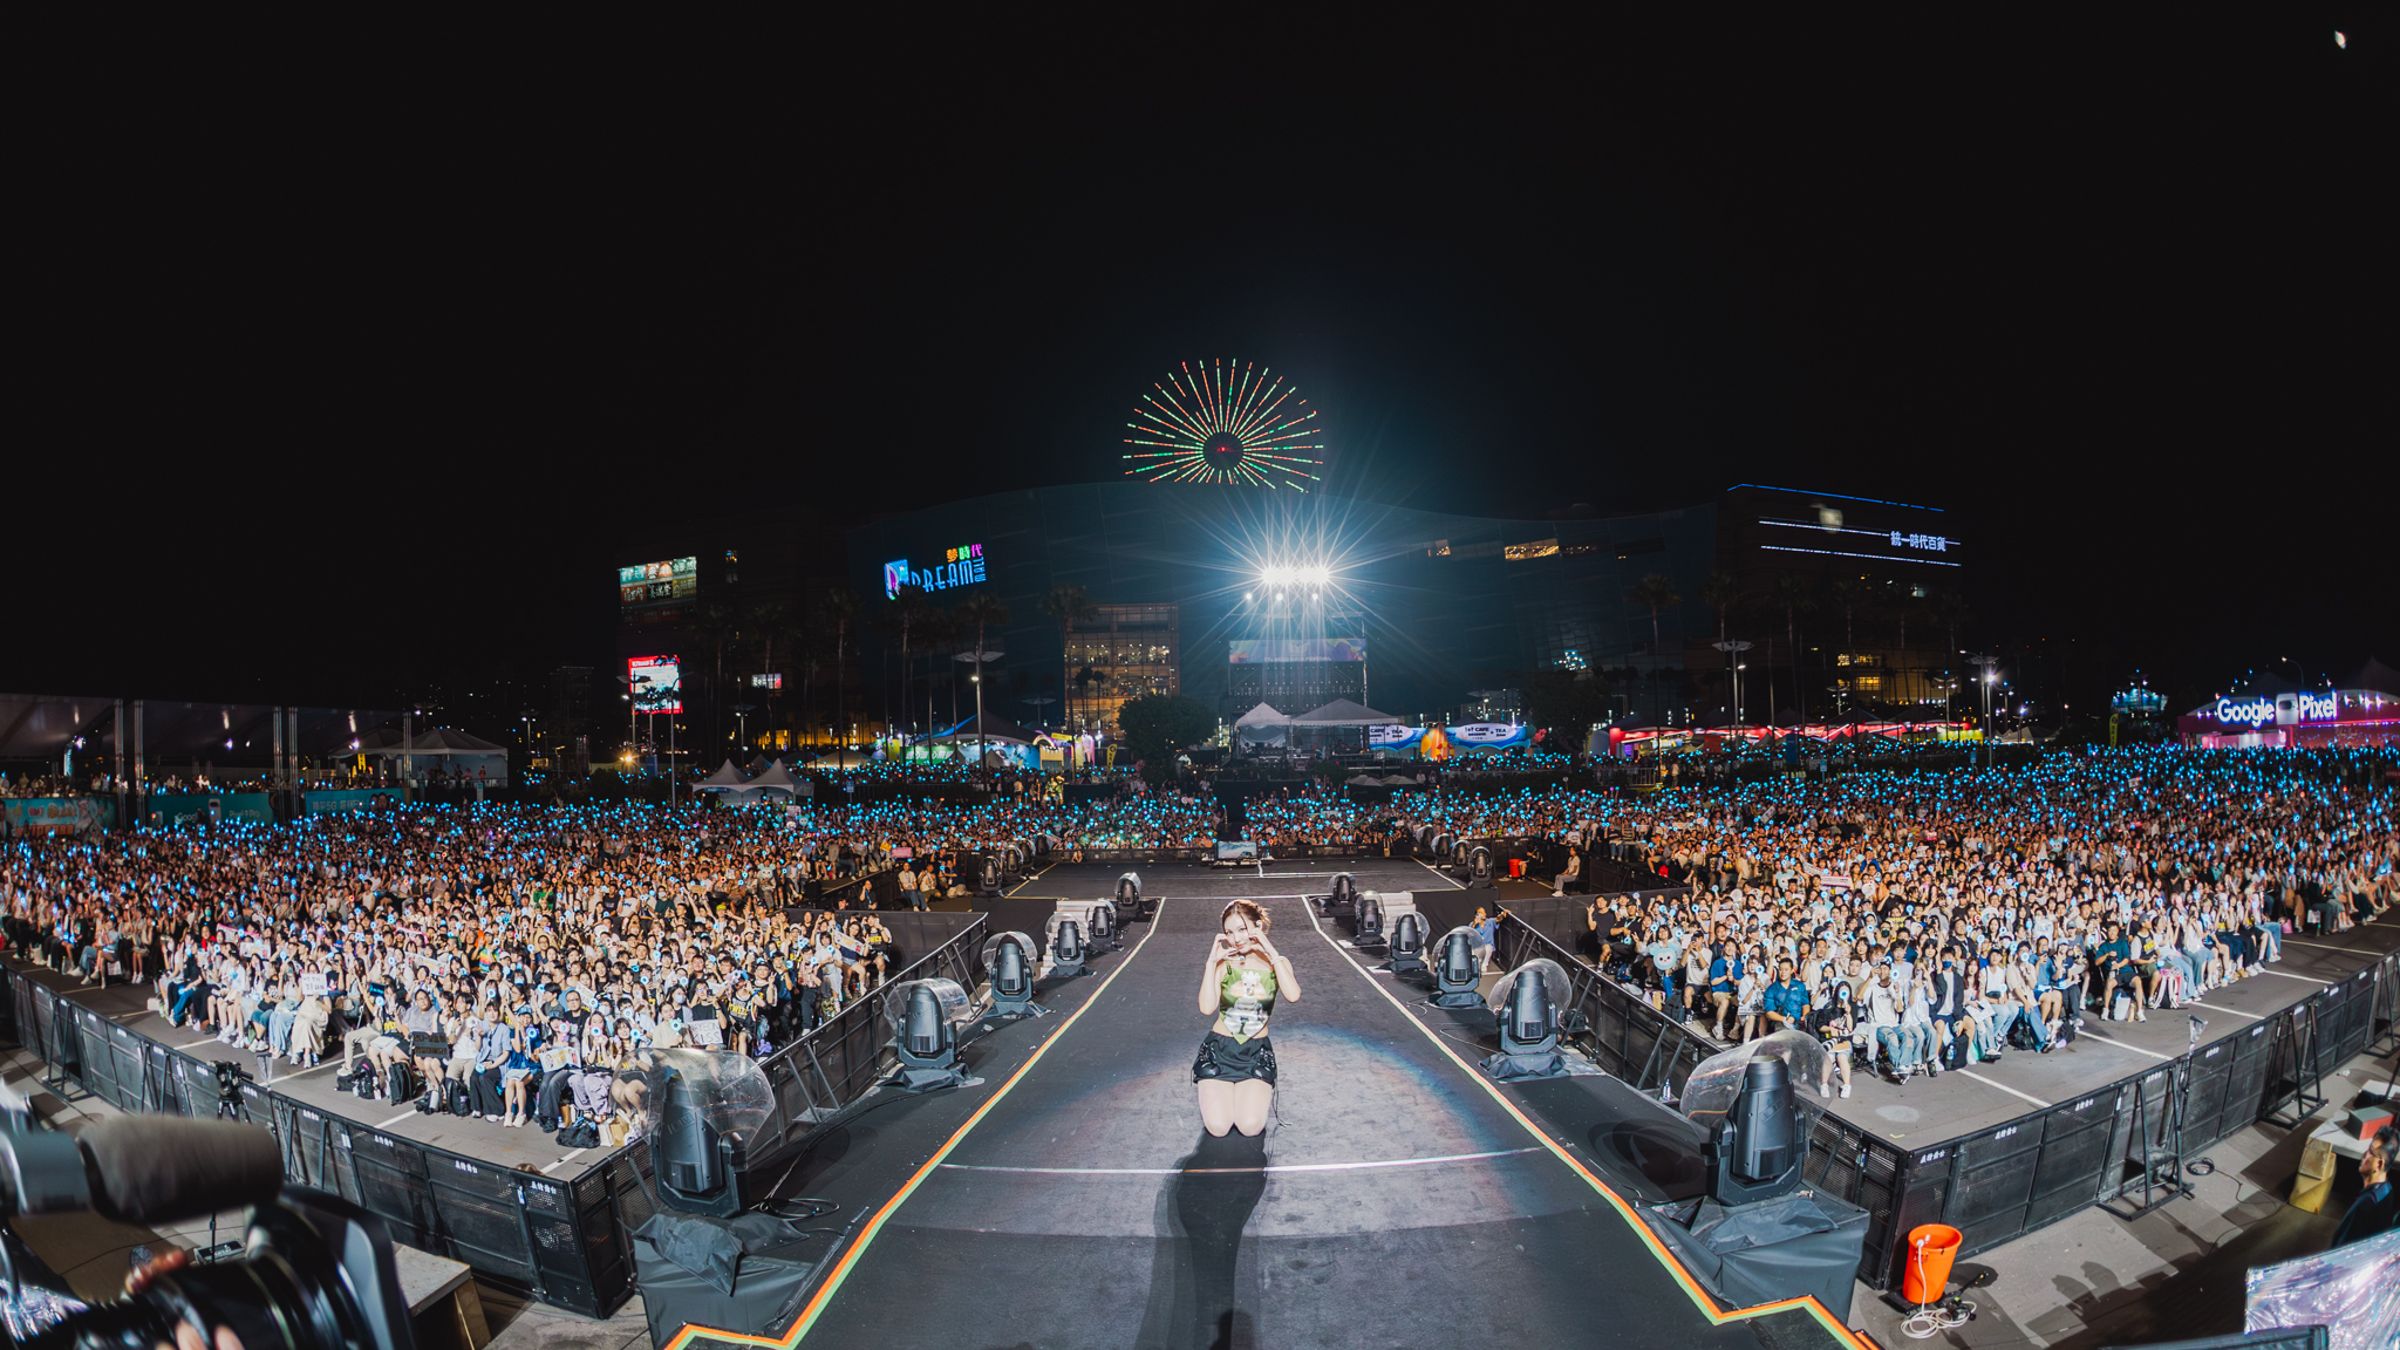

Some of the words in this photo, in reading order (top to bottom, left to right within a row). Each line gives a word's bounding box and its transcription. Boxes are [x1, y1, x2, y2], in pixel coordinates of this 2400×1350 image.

[946, 543, 983, 562] 夢時代
[1890, 531, 1946, 552] 統一時代百貨
[911, 560, 974, 592] DREAM
[973, 556, 986, 582] MALL
[2217, 697, 2275, 727] Google
[2299, 690, 2338, 720] Pixel
